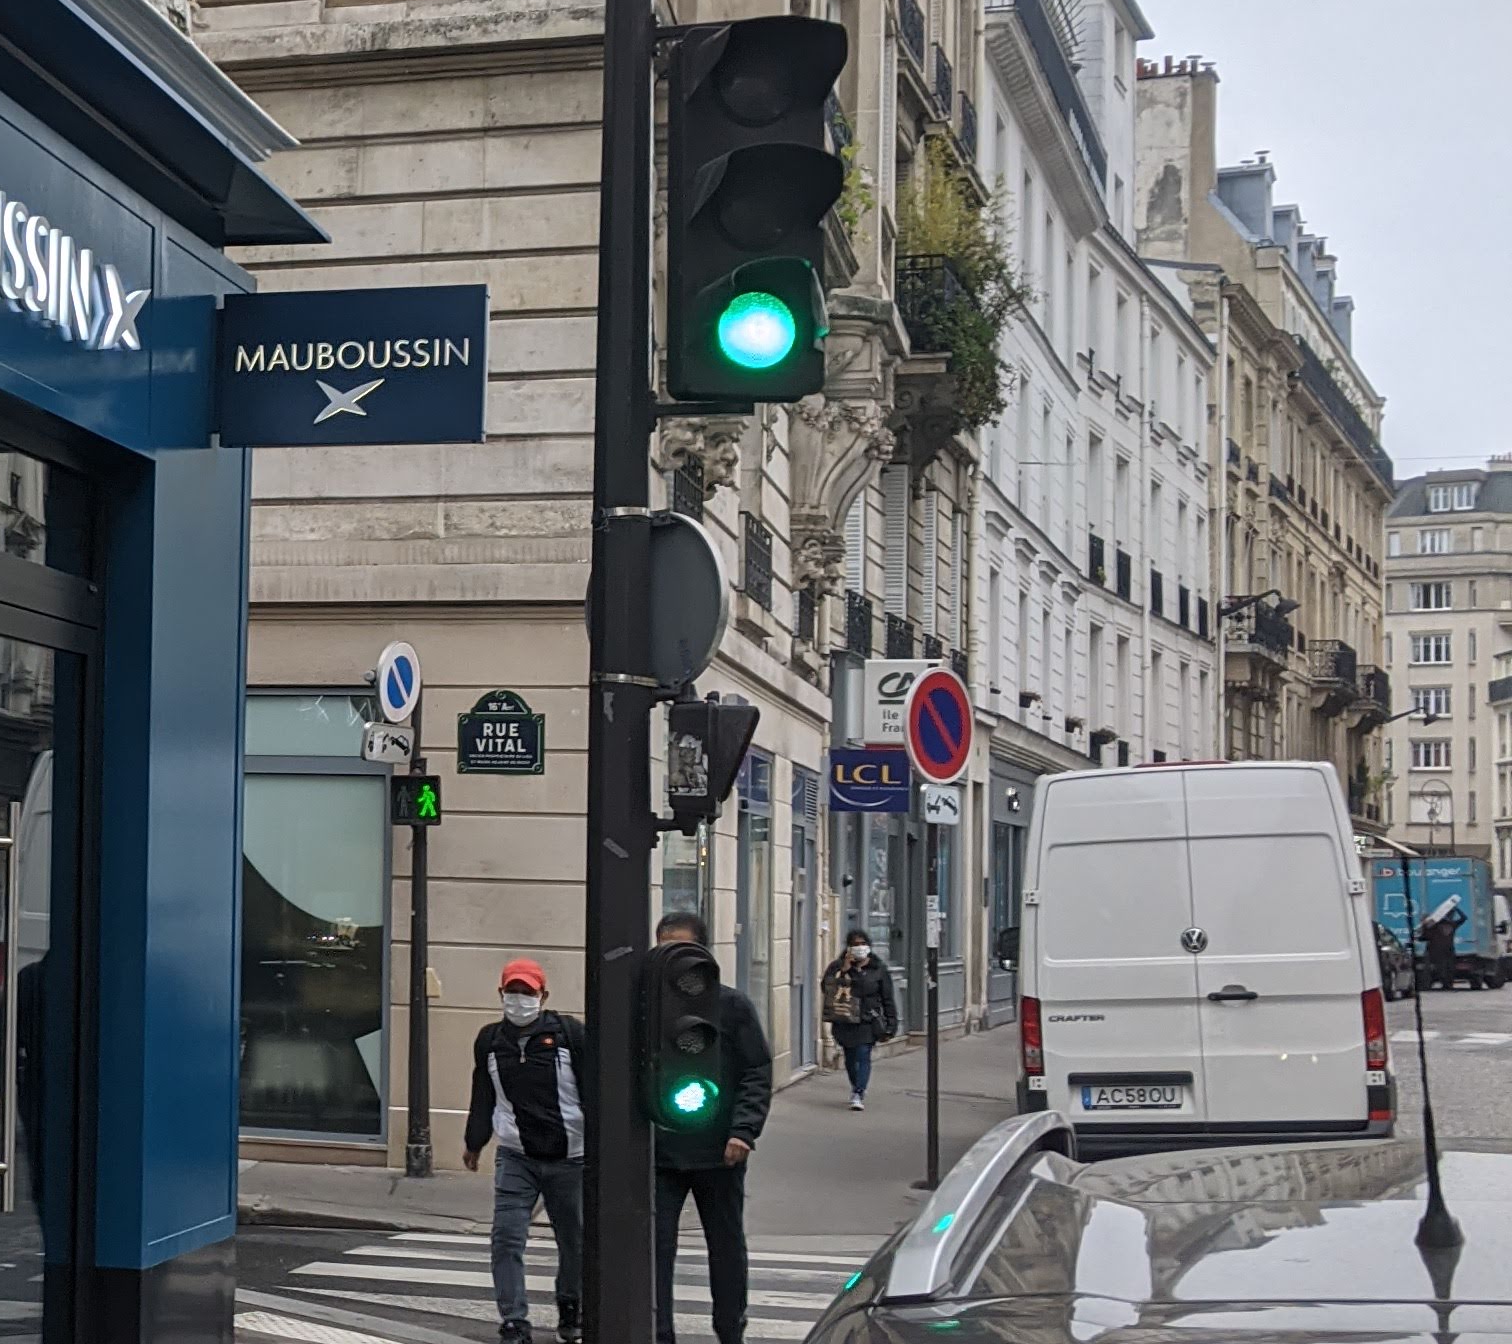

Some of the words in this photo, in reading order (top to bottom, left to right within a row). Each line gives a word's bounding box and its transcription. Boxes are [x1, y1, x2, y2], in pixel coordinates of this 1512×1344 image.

[235, 338, 470, 372] MAUBOUSSIN
[482, 722, 520, 737] RUE
[475, 738, 527, 753] VITAL
[834, 764, 902, 785] LCL
[1048, 1014, 1105, 1023] CRAFTER
